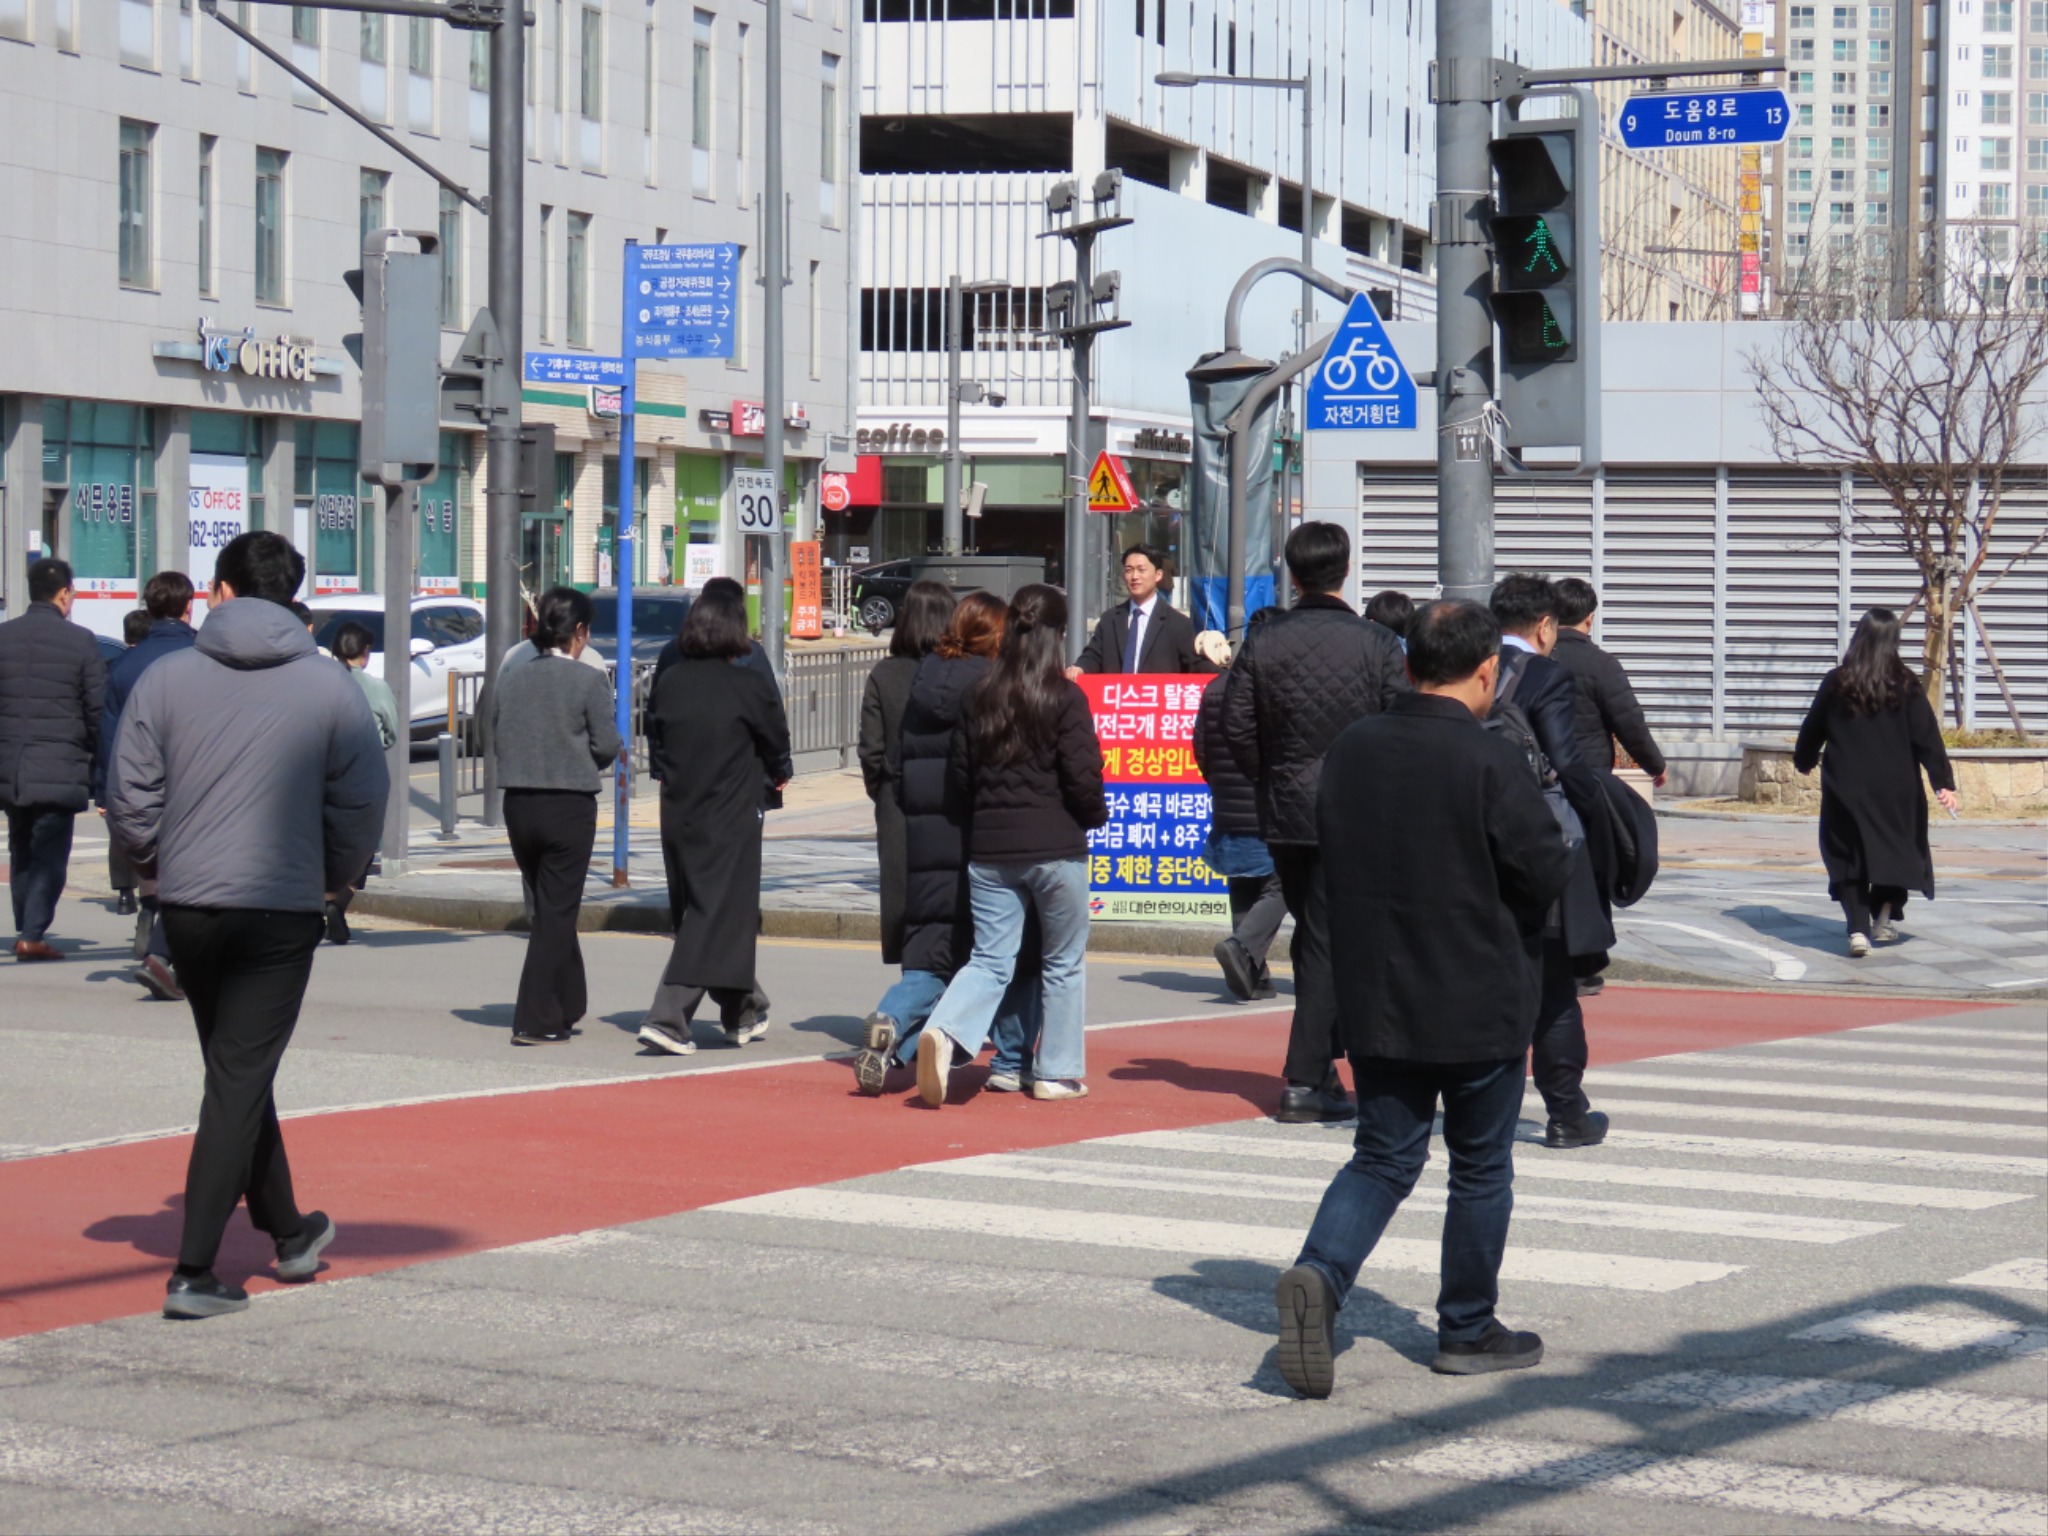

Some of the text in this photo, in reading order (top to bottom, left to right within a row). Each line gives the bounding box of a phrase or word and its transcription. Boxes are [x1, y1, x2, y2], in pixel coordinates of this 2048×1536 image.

[1663, 97, 1738, 123] 도움8로
[1765, 107, 1782, 124] 13
[1626, 115, 1637, 132] 9
[1665, 126, 1736, 143] Doum 8-ro
[660, 275, 714, 290] 공정거래위원회
[635, 334, 671, 347] 농식품부
[204, 335, 230, 372] KS
[1324, 404, 1400, 425] 자전거횡단
[856, 422, 944, 445] coffee
[1460, 437, 1475, 451] 11
[738, 476, 773, 489] 안전속도
[76, 482, 132, 524] 사무용품
[740, 494, 773, 527] 30
[797, 605, 817, 617] 주차
[796, 618, 817, 632] 금지
[1103, 683, 1207, 710] 디스크 탈출
[1132, 791, 1162, 819] 왜곡
[1127, 821, 1156, 849] 폐지
[1174, 823, 1200, 850] 8주
[1115, 854, 1153, 885] 제한
[1129, 900, 1227, 916] 대한한의사협회
